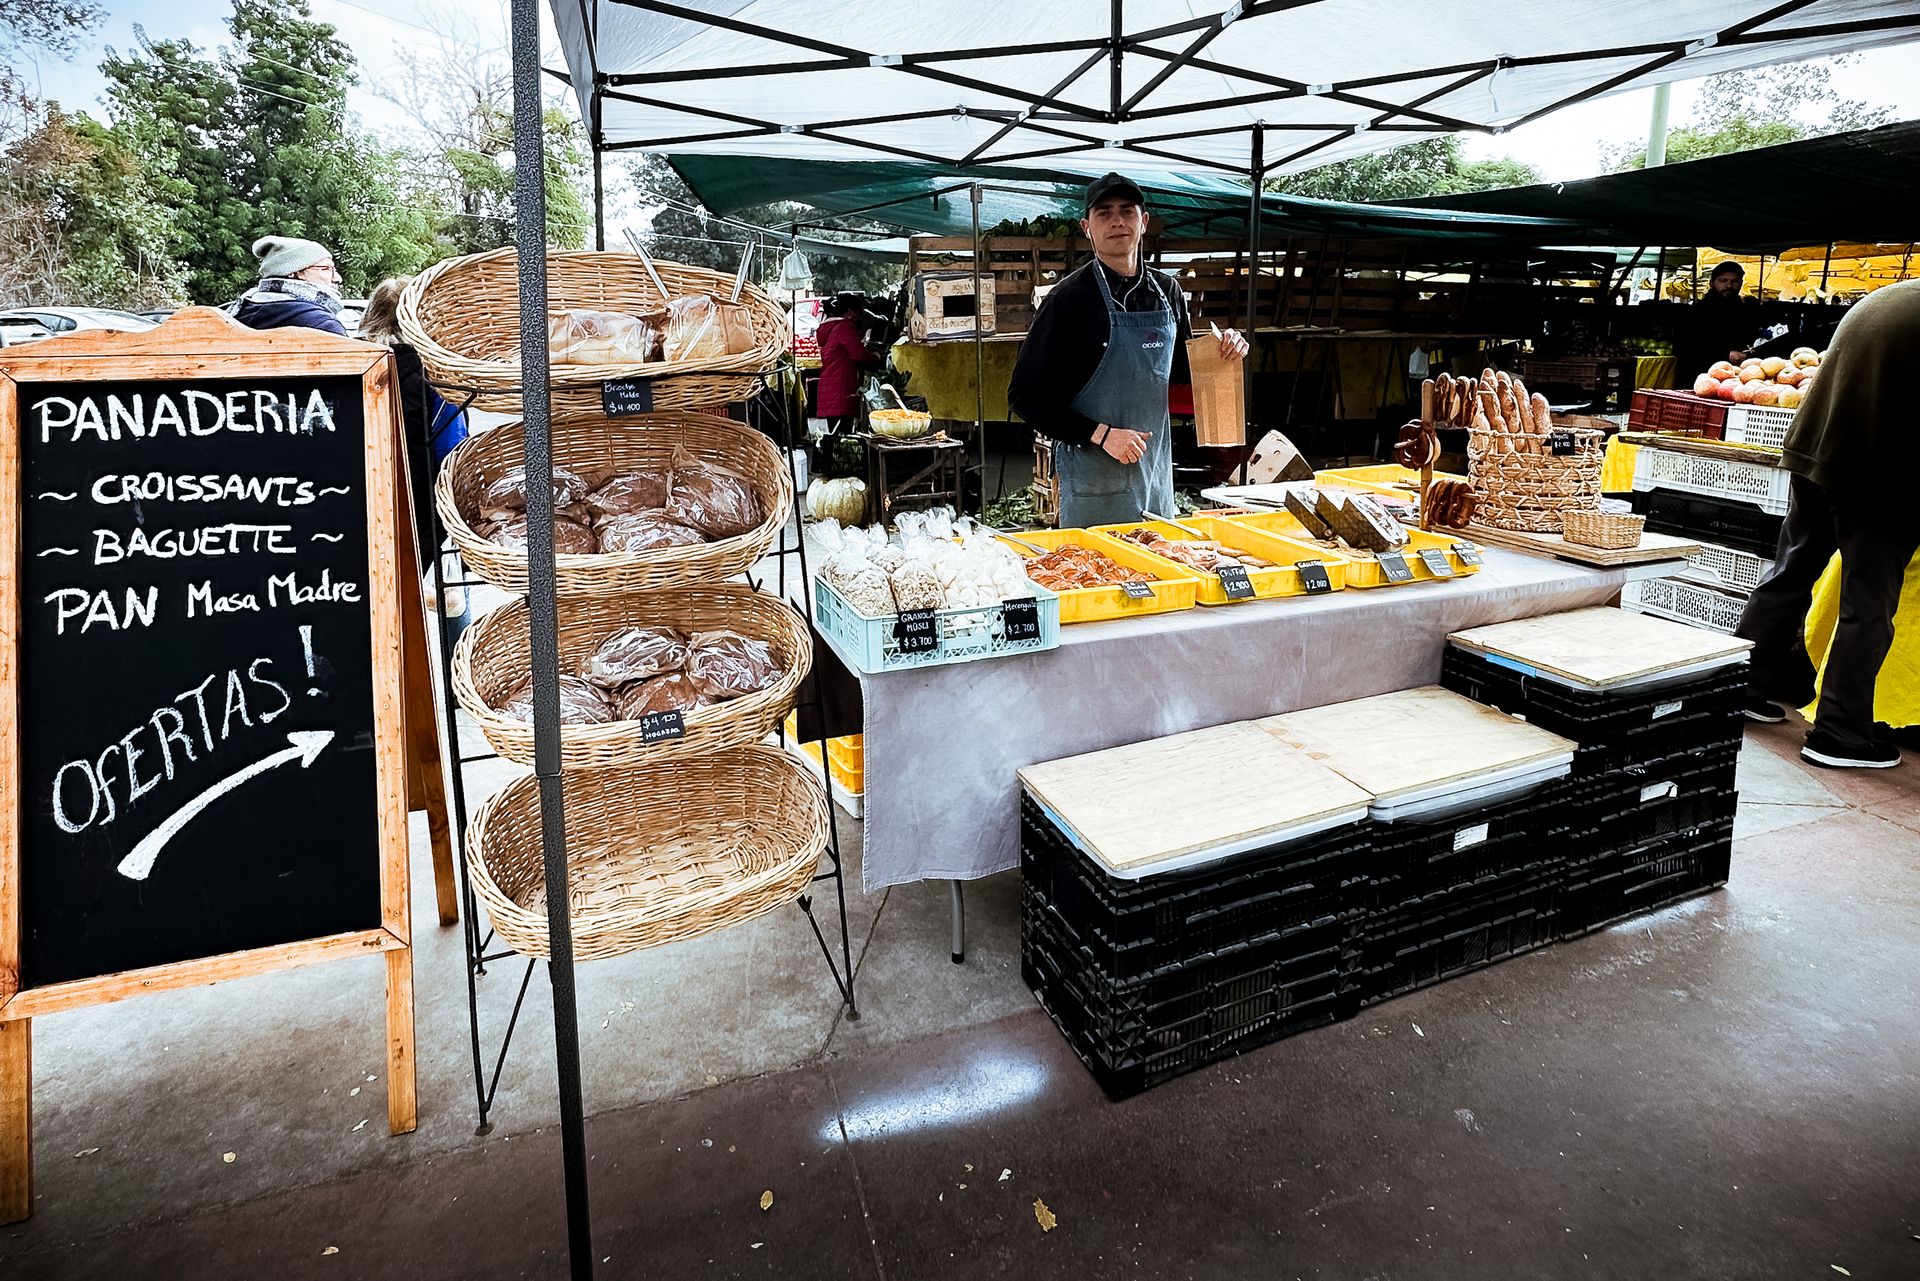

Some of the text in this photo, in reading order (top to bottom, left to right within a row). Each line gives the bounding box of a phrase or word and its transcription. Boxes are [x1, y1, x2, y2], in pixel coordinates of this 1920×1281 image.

[32, 389, 335, 443] PANADERIA
[92, 472, 317, 506] CROISSANTS
[93, 523, 296, 565] BAGUETTE
[45, 568, 362, 635] PAN Masa Madre
[900, 611, 935, 623] GRANOLA
